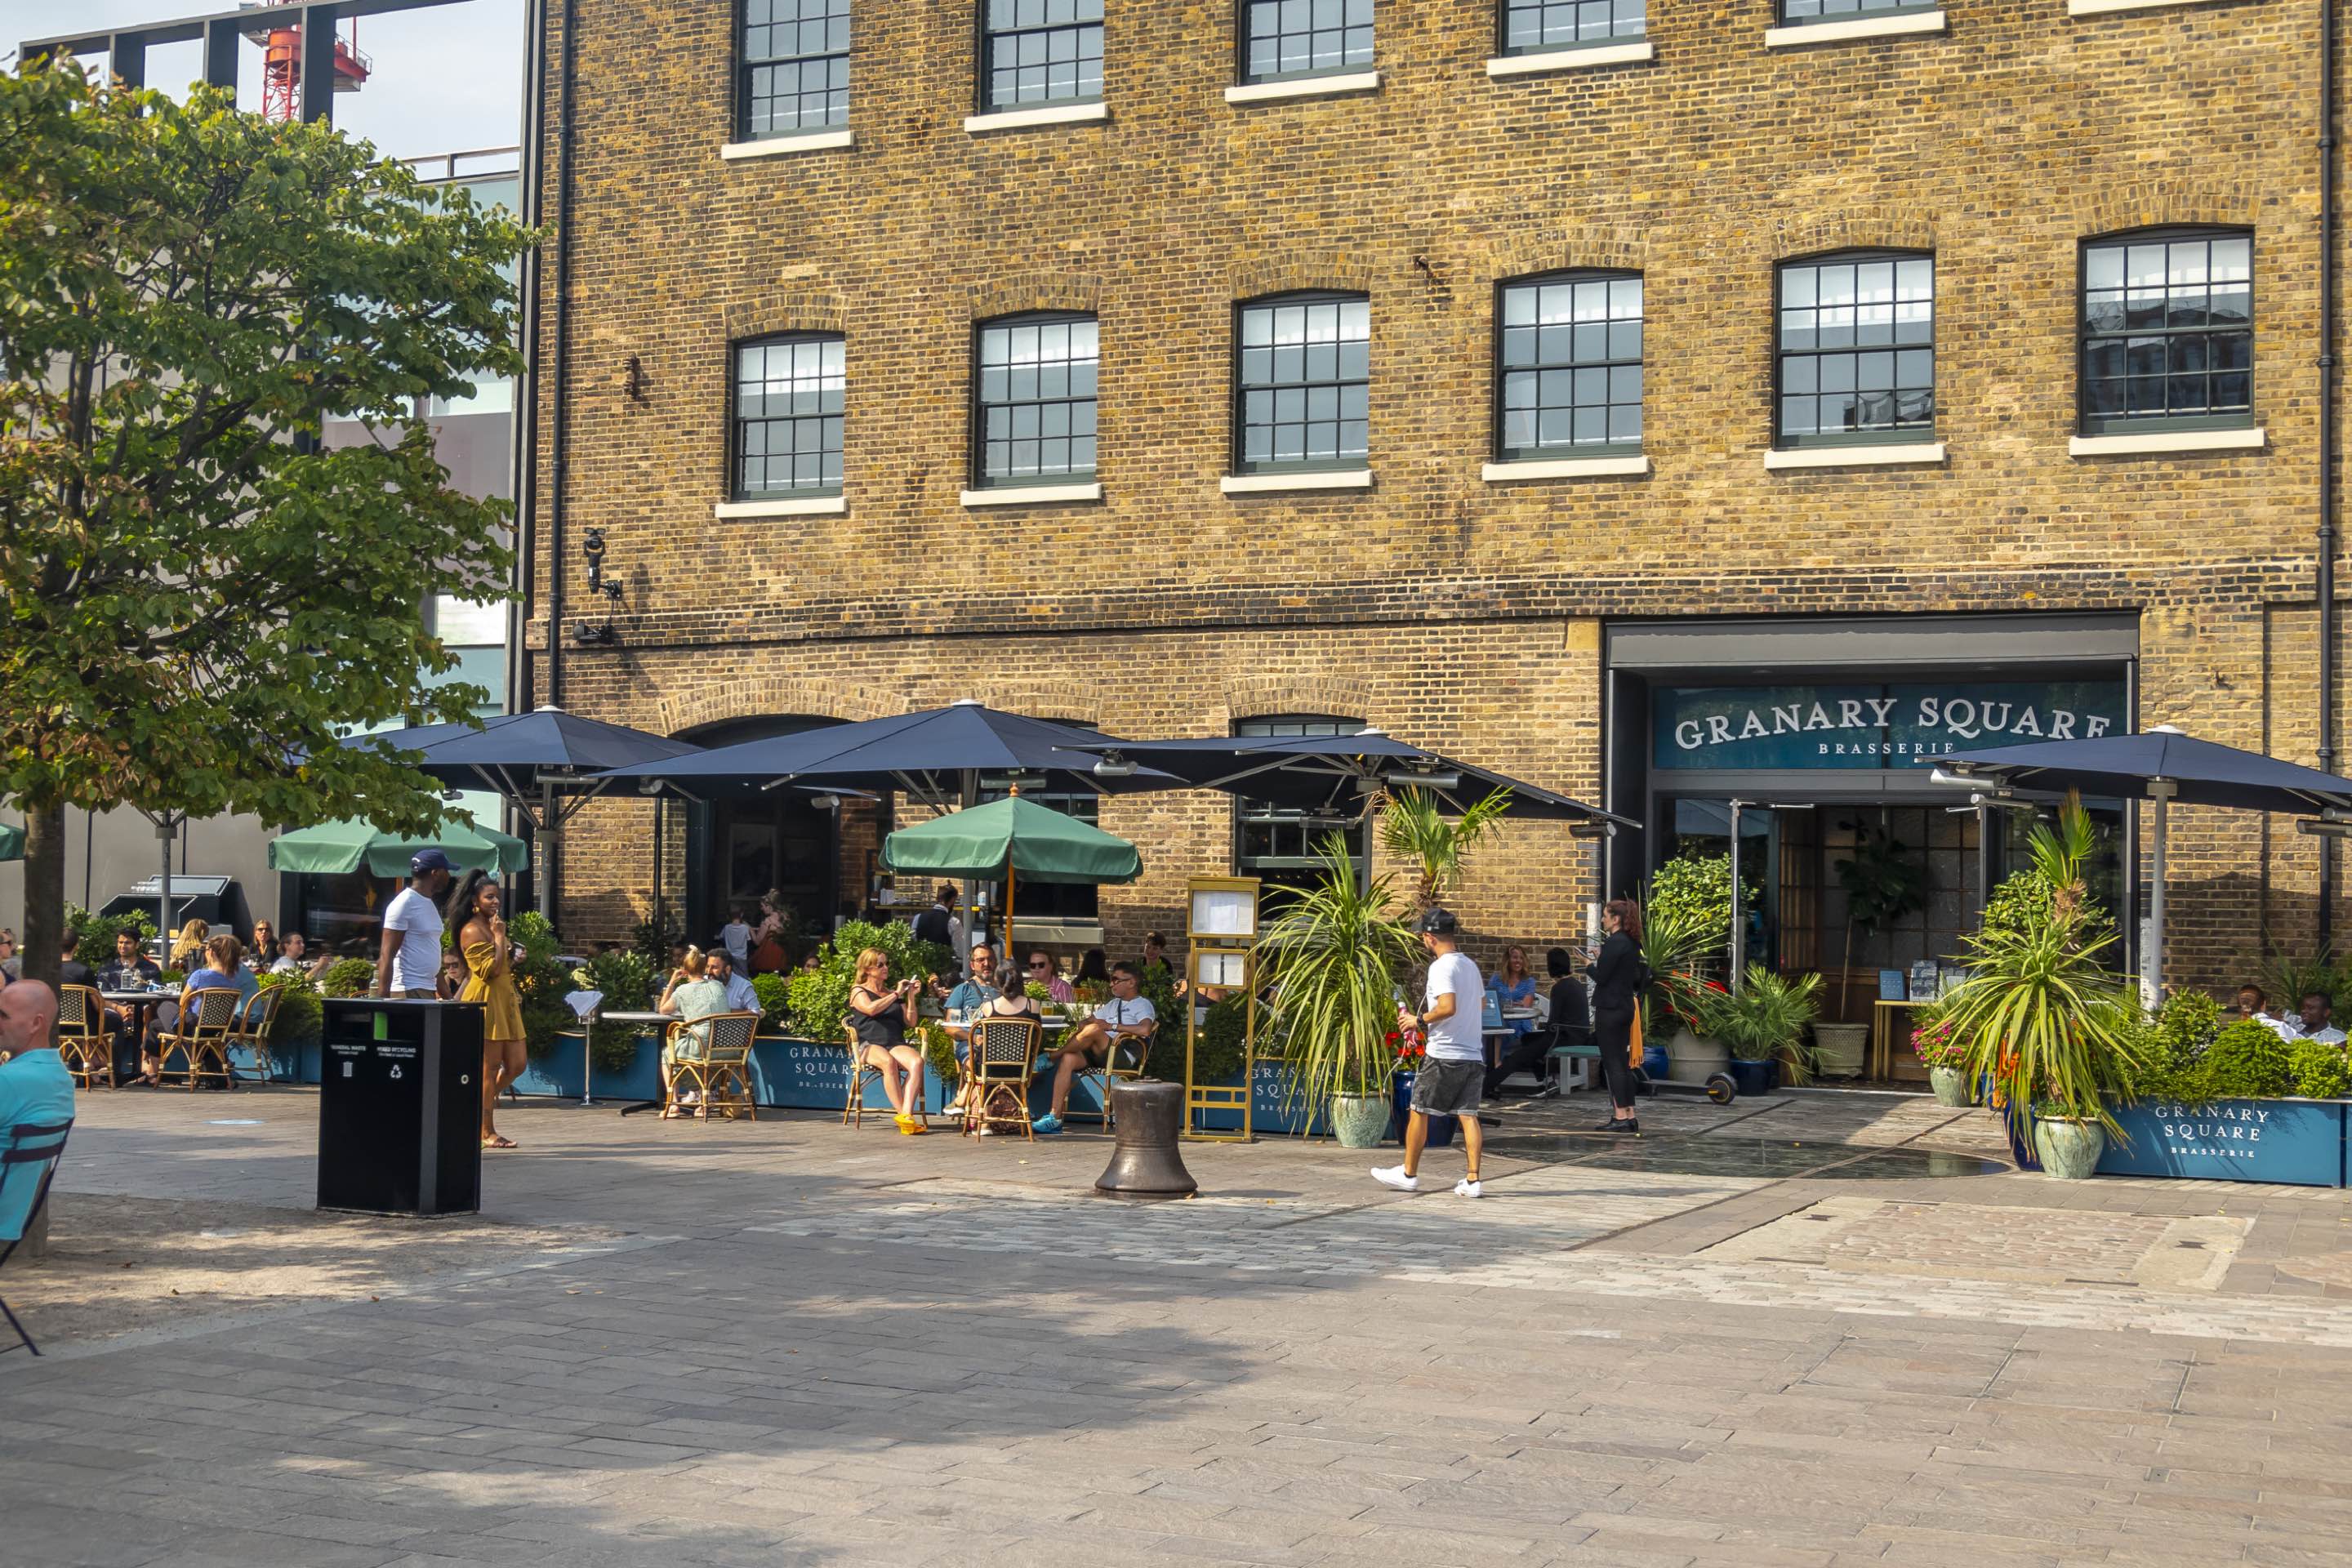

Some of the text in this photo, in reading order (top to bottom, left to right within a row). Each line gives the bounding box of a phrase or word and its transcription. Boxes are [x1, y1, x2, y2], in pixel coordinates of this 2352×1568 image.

[1675, 697, 2110, 750] GRANARY SQUARE
[1819, 743, 1953, 755] BRASSERIE
[790, 1046, 851, 1058] GRANA
[795, 1062, 856, 1076] SQUAR
[799, 1081, 849, 1089] BRSSERI
[2164, 1124, 2261, 1141] SQUARE
[2171, 1147, 2255, 1158] BRASSERIE
